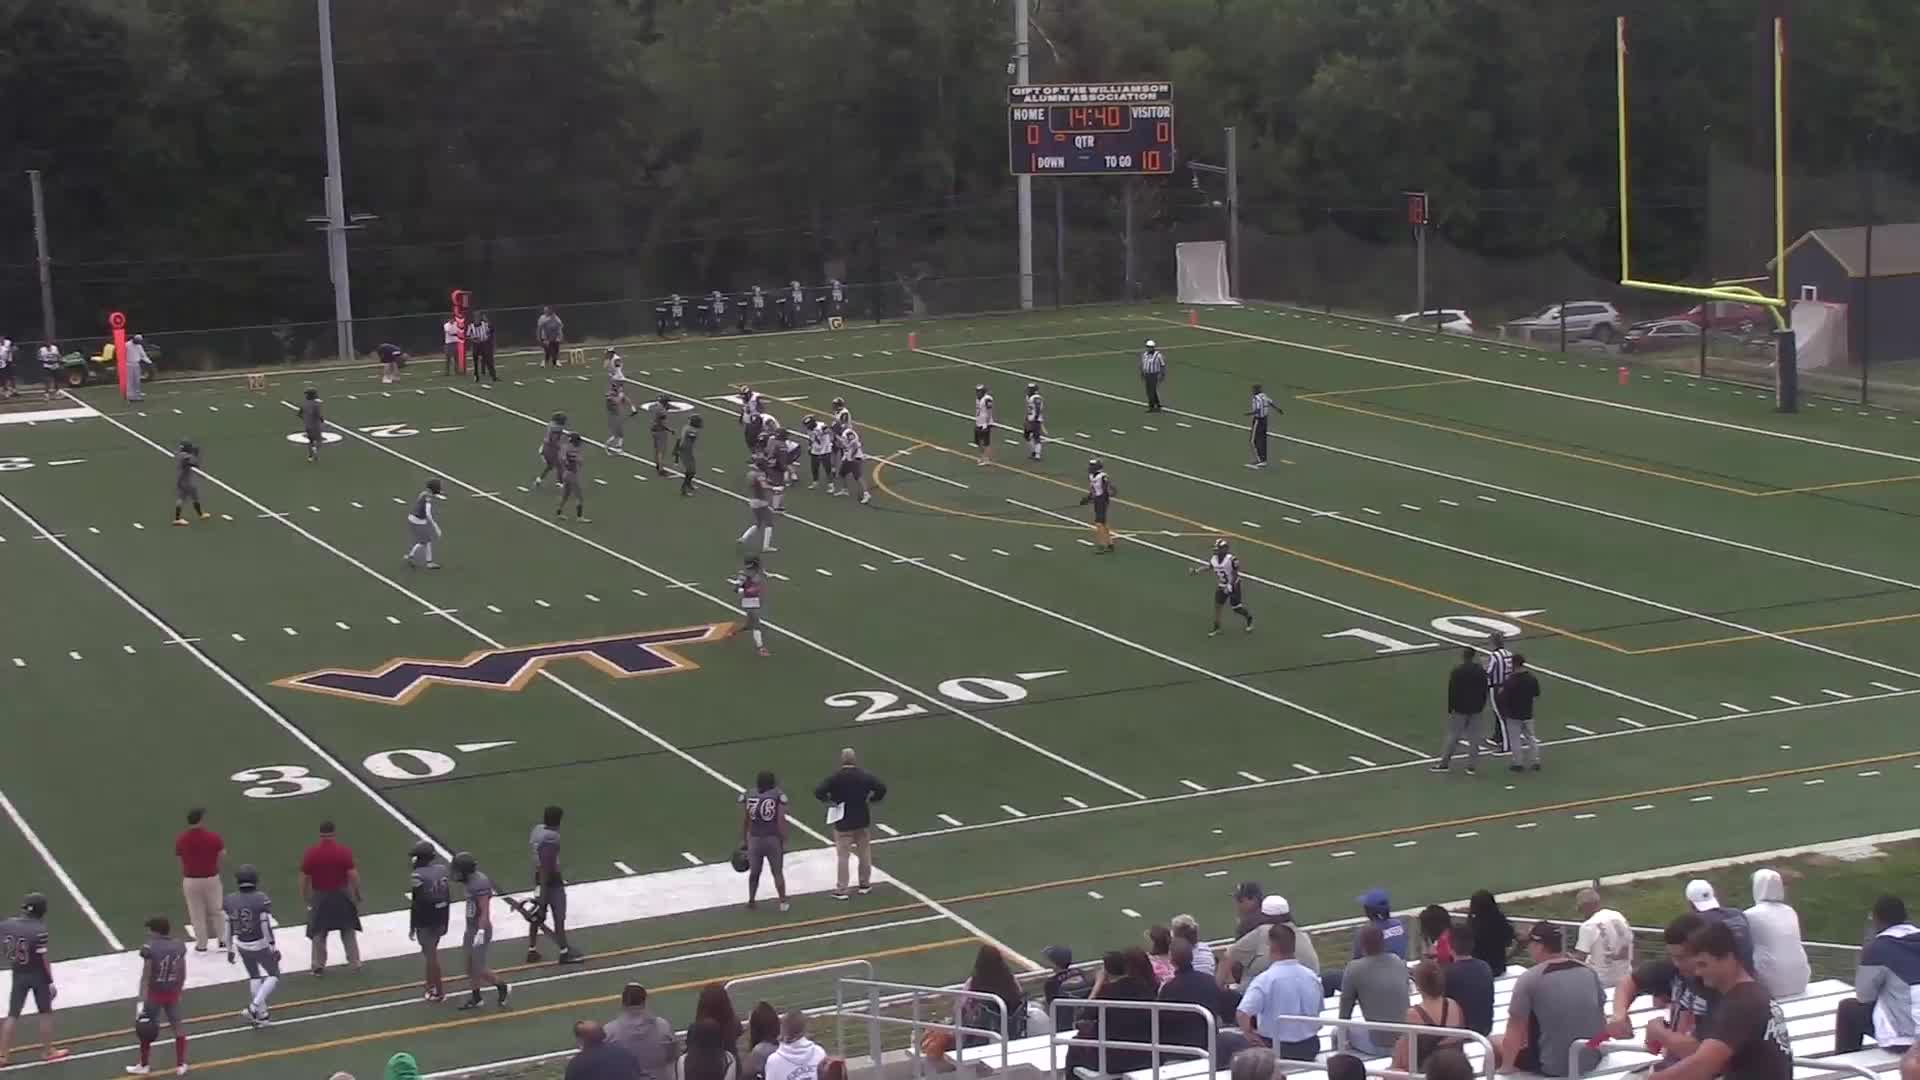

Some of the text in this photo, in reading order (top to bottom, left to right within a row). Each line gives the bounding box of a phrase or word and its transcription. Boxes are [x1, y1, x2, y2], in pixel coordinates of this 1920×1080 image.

[1012, 84, 1169, 96] GIFT OF THE WILLIAMSON
[1023, 93, 1157, 103] ALUMNI ASSOCIATION
[1013, 108, 1045, 121] HOME
[1069, 106, 1121, 128] 14:40
[1131, 106, 1171, 119] VISITOR
[1027, 124, 1040, 145] 0
[1156, 122, 1169, 142] 0
[1074, 135, 1095, 149] QTR
[1037, 156, 1065, 169] DOWN
[1104, 155, 1132, 168] TO GO
[1142, 150, 1160, 171] 10
[824, 675, 1029, 723] 20
[230, 748, 457, 800] 30
[746, 797, 777, 822] 76
